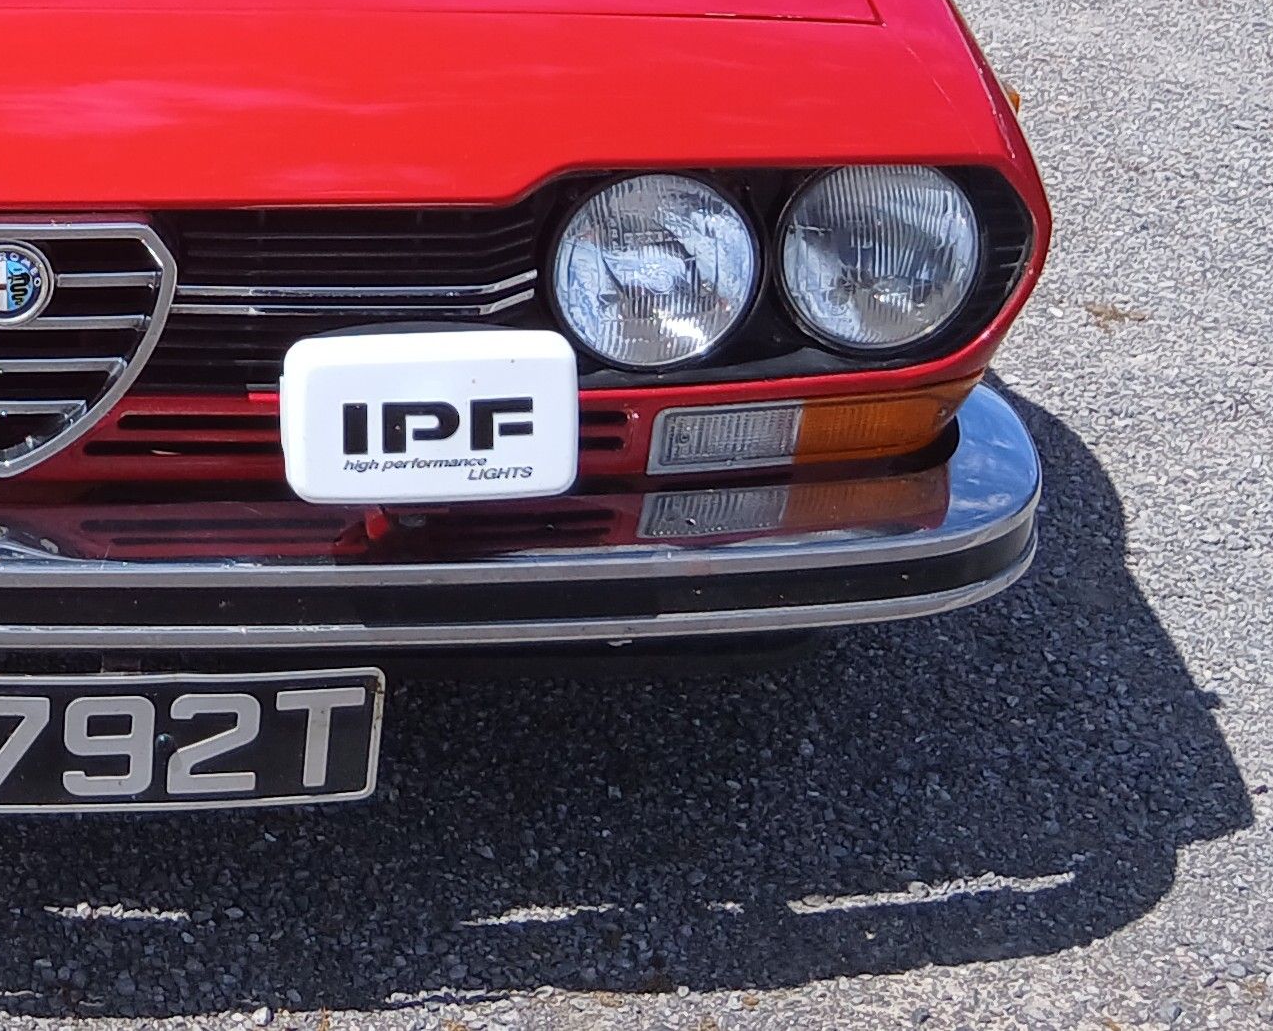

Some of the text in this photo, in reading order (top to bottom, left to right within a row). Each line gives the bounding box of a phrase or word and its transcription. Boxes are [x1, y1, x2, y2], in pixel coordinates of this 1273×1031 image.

[342, 396, 534, 456] IPF
[343, 456, 488, 473] high performance
[467, 465, 534, 482] LIGHTS
